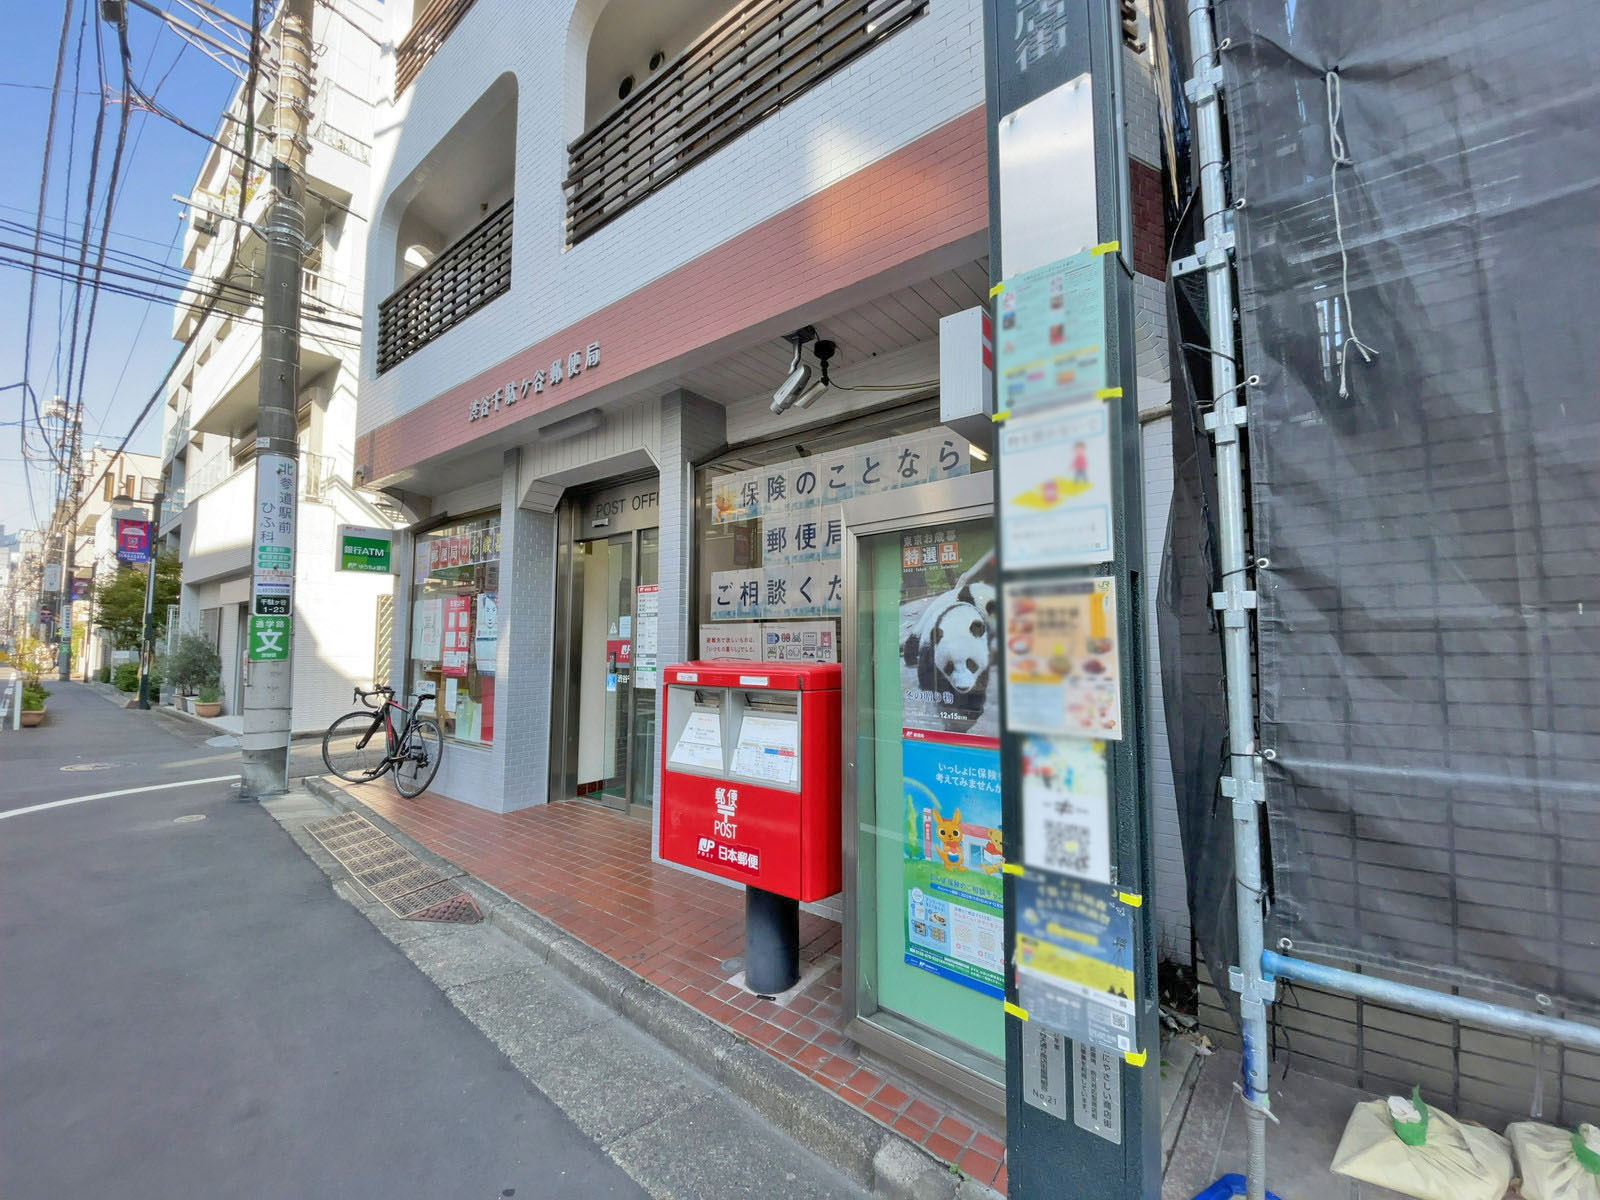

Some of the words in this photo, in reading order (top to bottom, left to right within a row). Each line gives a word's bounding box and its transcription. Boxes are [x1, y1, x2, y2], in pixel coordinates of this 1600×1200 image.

[739, 440, 961, 507] 保険のことなら
[278, 462, 293, 535] 北参道駅前
[596, 498, 626, 517] POST
[260, 502, 276, 543] ひふ科
[343, 545, 385, 557] 銀行ATM
[904, 544, 958, 566] 特選品
[255, 618, 285, 628] 通学路
[938, 763, 1001, 781] いっしょに保険
[715, 787, 738, 808] 郵便
[714, 820, 738, 840] POST
[718, 845, 759, 870] 日本郵便
